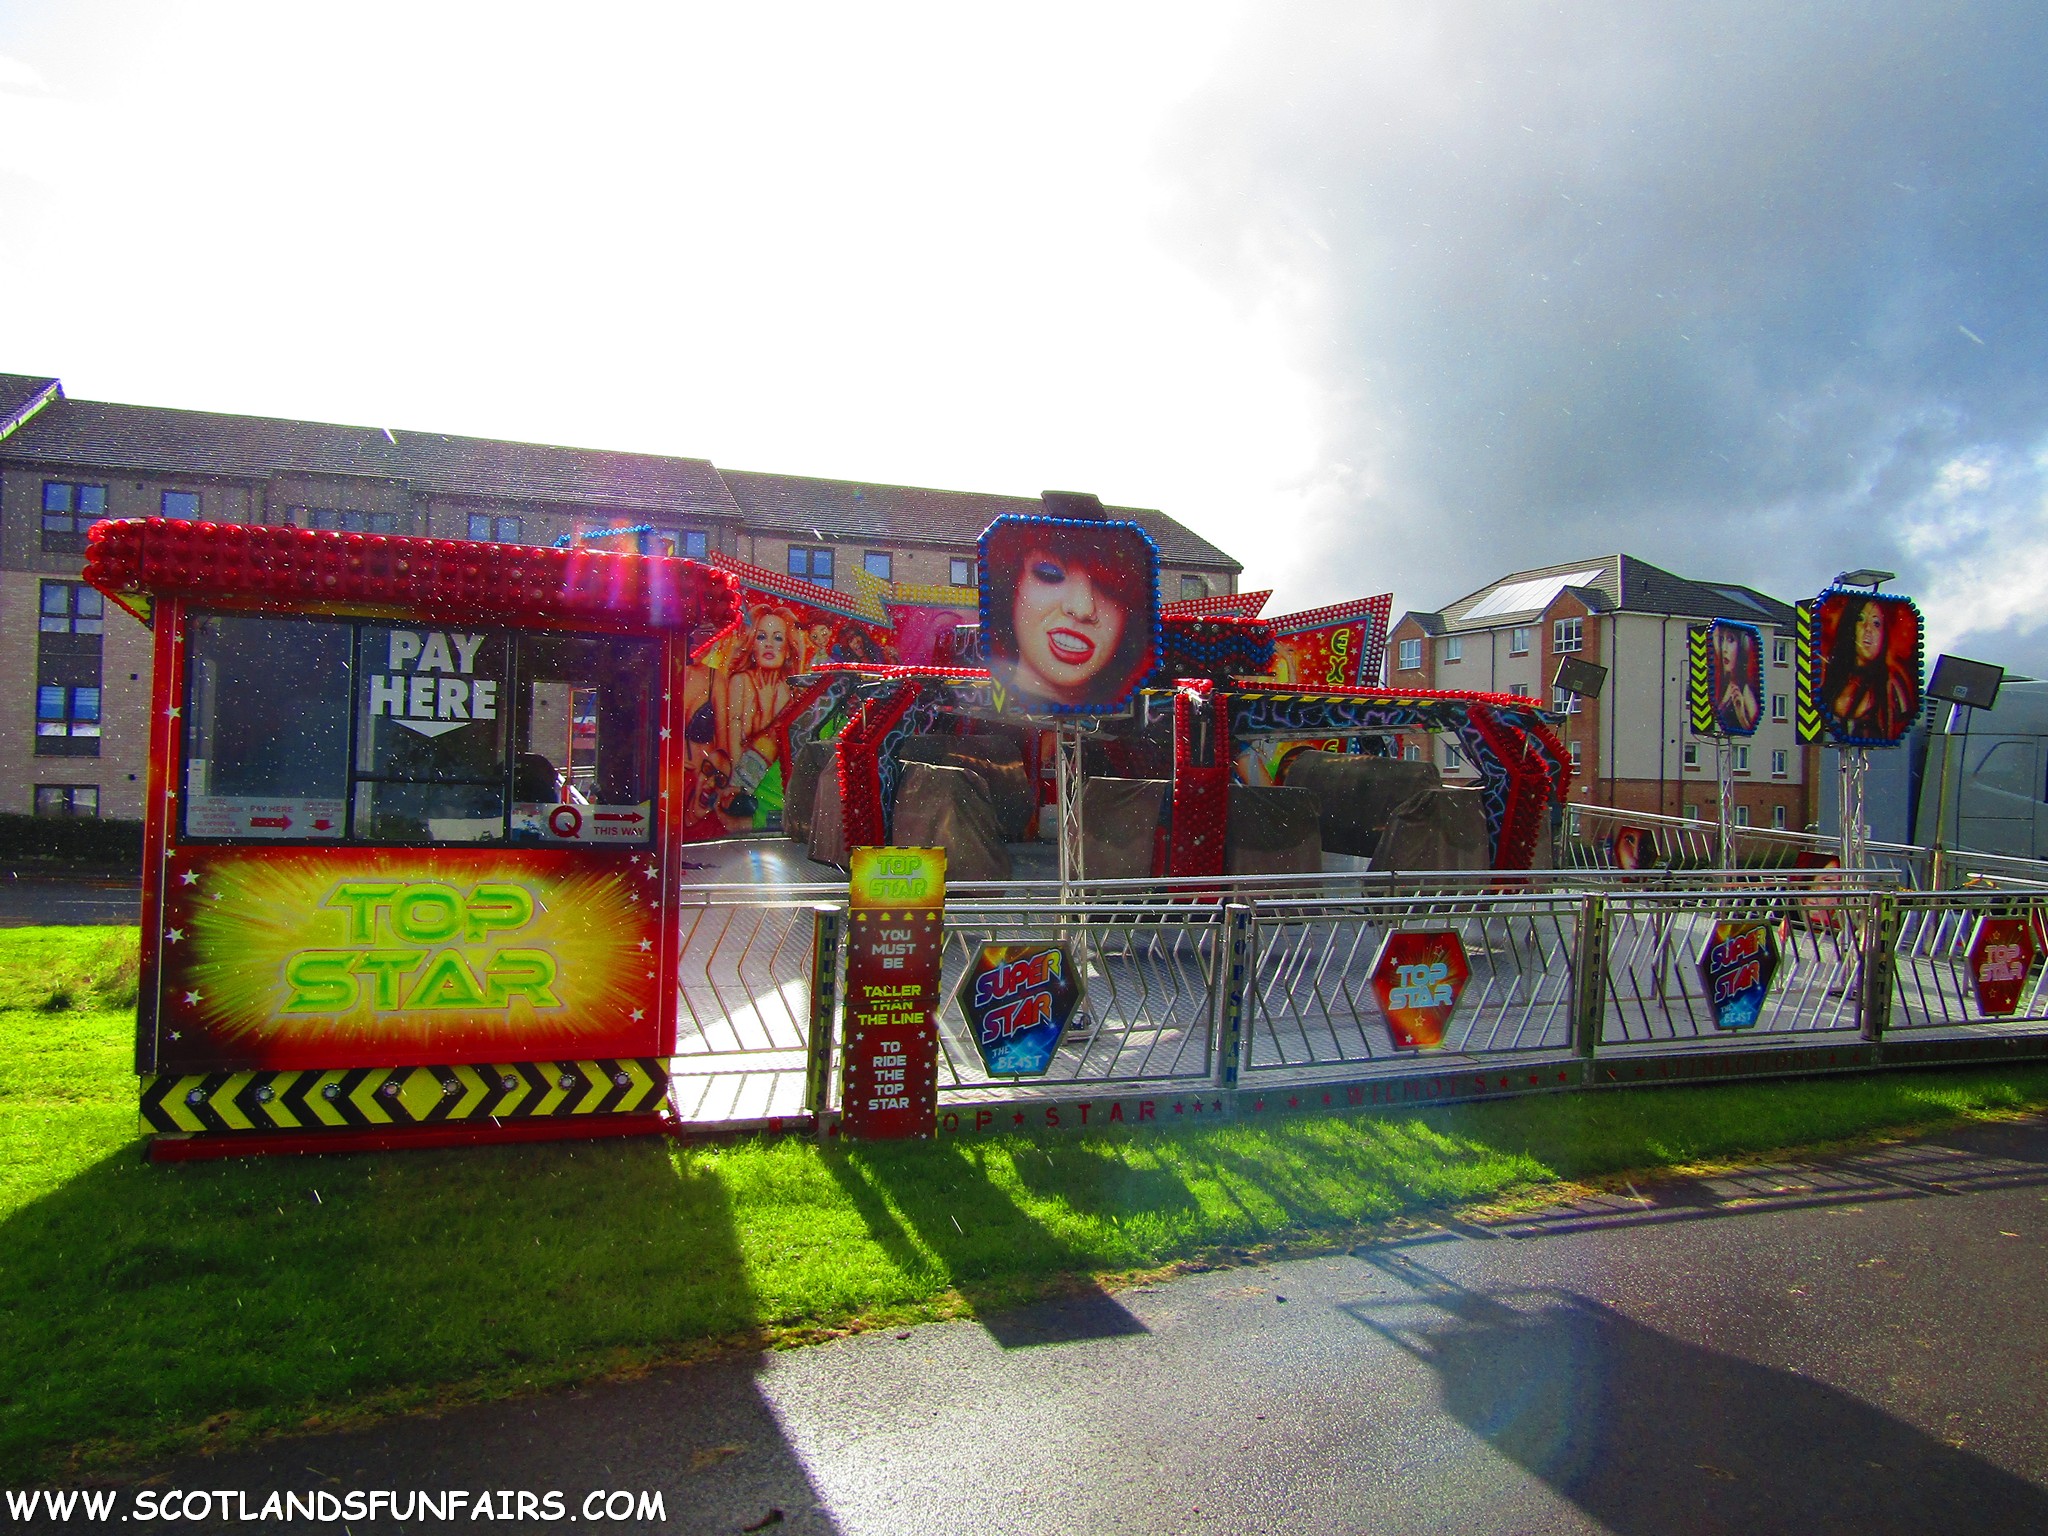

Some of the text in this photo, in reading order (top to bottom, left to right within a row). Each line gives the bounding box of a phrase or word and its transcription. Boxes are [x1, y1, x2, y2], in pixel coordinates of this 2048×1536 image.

[389, 630, 486, 673] PAY
[370, 674, 497, 719] HERE
[251, 804, 266, 813] PAY
[269, 805, 294, 813] HERE
[549, 805, 582, 839] Q
[594, 826, 645, 836] THIS WAY
[876, 855, 923, 876] TOP
[869, 877, 927, 899] STAR
[324, 882, 534, 945] TOP
[880, 929, 912, 941] YOU
[872, 943, 917, 956] MUST
[1710, 925, 1767, 974] SUPER
[1984, 944, 2020, 963] TOP
[883, 957, 904, 969] BE
[975, 949, 1062, 1008] SUPER
[1396, 962, 1448, 988] TOP
[1978, 961, 2023, 982] STAR
[278, 947, 562, 1013] STAR
[1714, 960, 1760, 1003] STAR
[862, 984, 922, 997] TALLER
[1388, 983, 1453, 1010] STAR
[870, 999, 913, 1011] THAN
[1721, 1002, 1733, 1013] THE
[857, 1012, 925, 1026] THE LINE
[982, 991, 1053, 1045] STAR
[1724, 1011, 1752, 1024] BEAST
[880, 1041, 901, 1053] TO
[992, 1046, 1010, 1059] THE
[872, 1055, 907, 1067] RIDE
[997, 1055, 1043, 1070] BEAST
[874, 1069, 905, 1081] THE
[874, 1084, 905, 1096] TOP
[868, 1097, 910, 1111] STAR
[943, 1100, 1156, 1133] OP STAR
